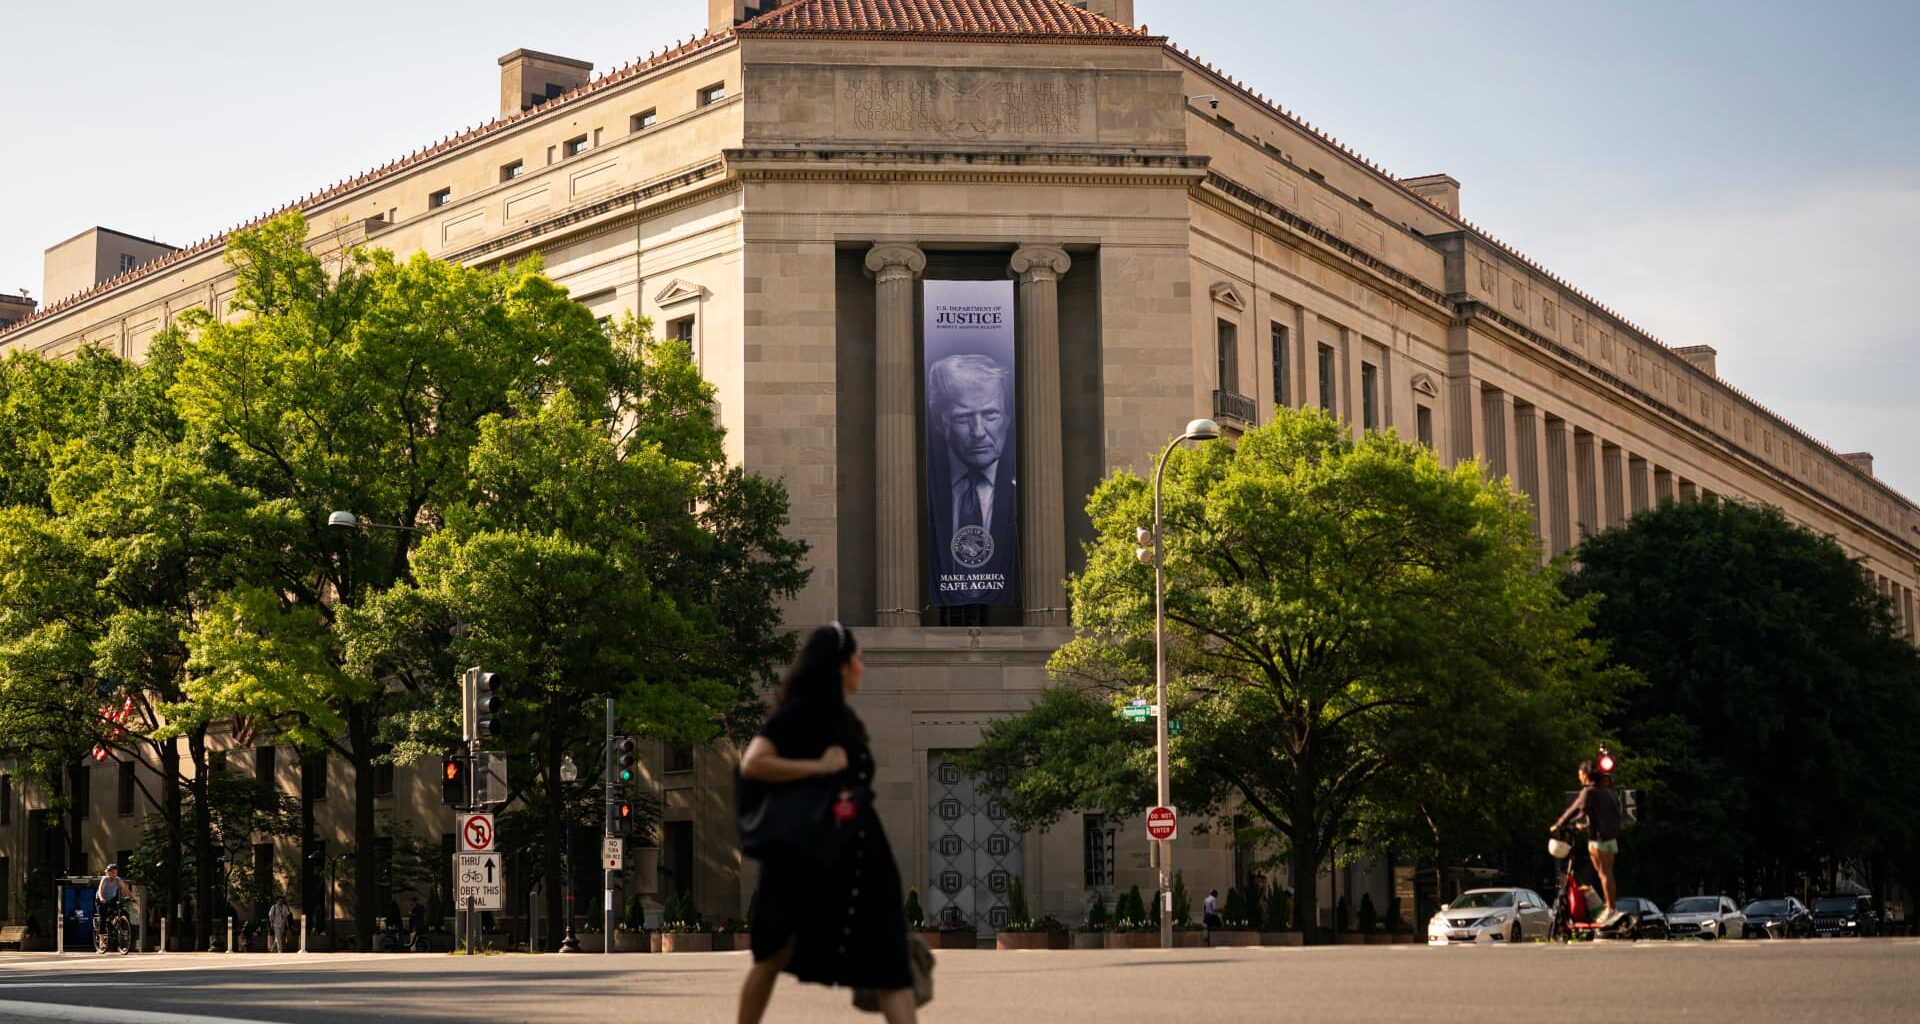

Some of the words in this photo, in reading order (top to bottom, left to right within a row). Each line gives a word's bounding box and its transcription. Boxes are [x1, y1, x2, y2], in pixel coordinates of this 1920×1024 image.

[1026, 123, 1081, 134] CITIZENS
[936, 312, 1002, 324] JUSTICE
[940, 582, 968, 591] SAFE
[970, 581, 1005, 590] AGAIN
[461, 856, 480, 866] THRU
[460, 886, 480, 895] OBEY
[483, 885, 499, 895] THIS
[460, 896, 487, 906] SINAL
